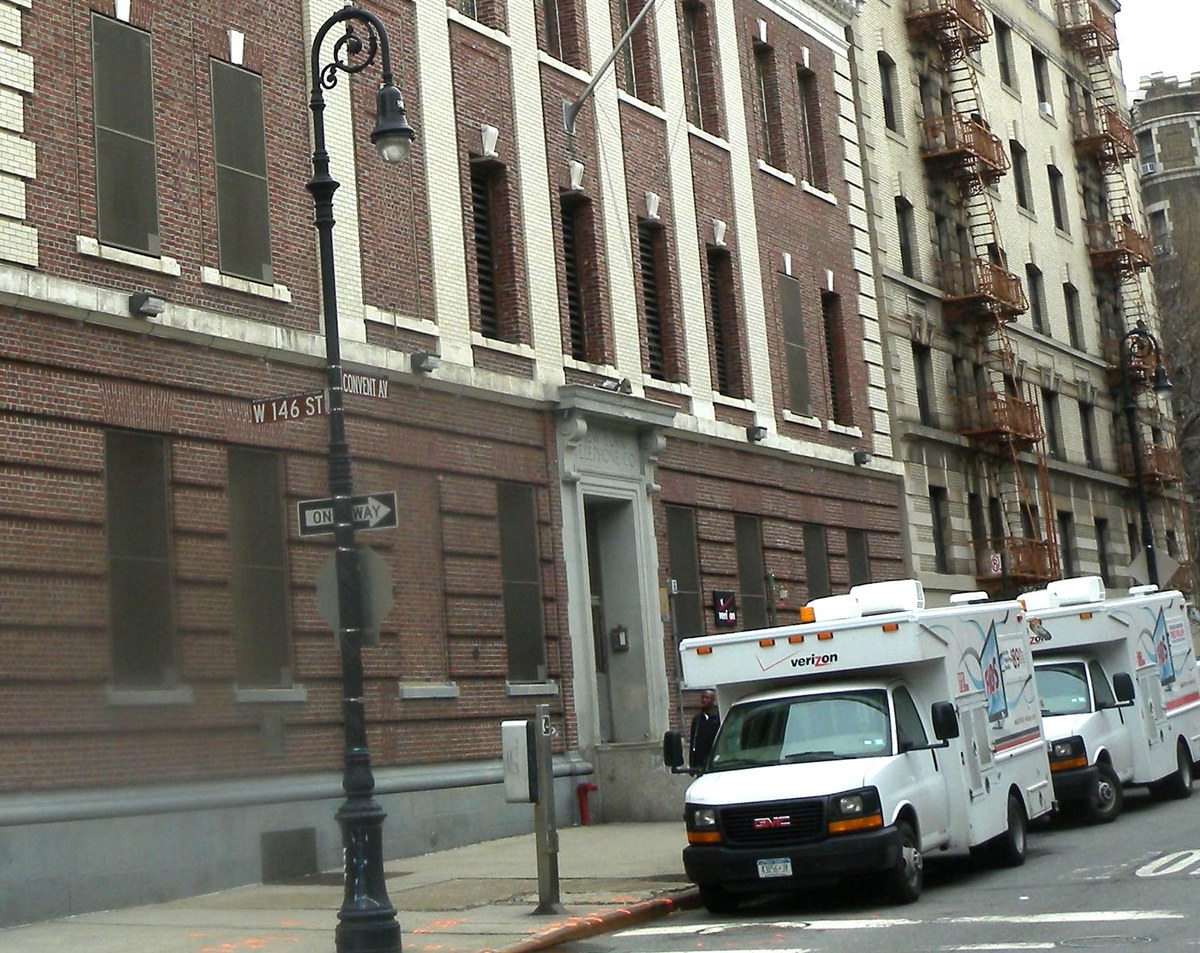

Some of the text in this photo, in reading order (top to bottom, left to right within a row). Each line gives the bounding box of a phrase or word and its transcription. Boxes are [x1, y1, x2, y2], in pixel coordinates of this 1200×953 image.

[342, 373, 388, 398] CONVENT AV
[253, 395, 323, 423] W 146 ST
[312, 504, 381, 524] ON WAY
[791, 653, 838, 667] verizon
[753, 816, 791, 828] GMC
